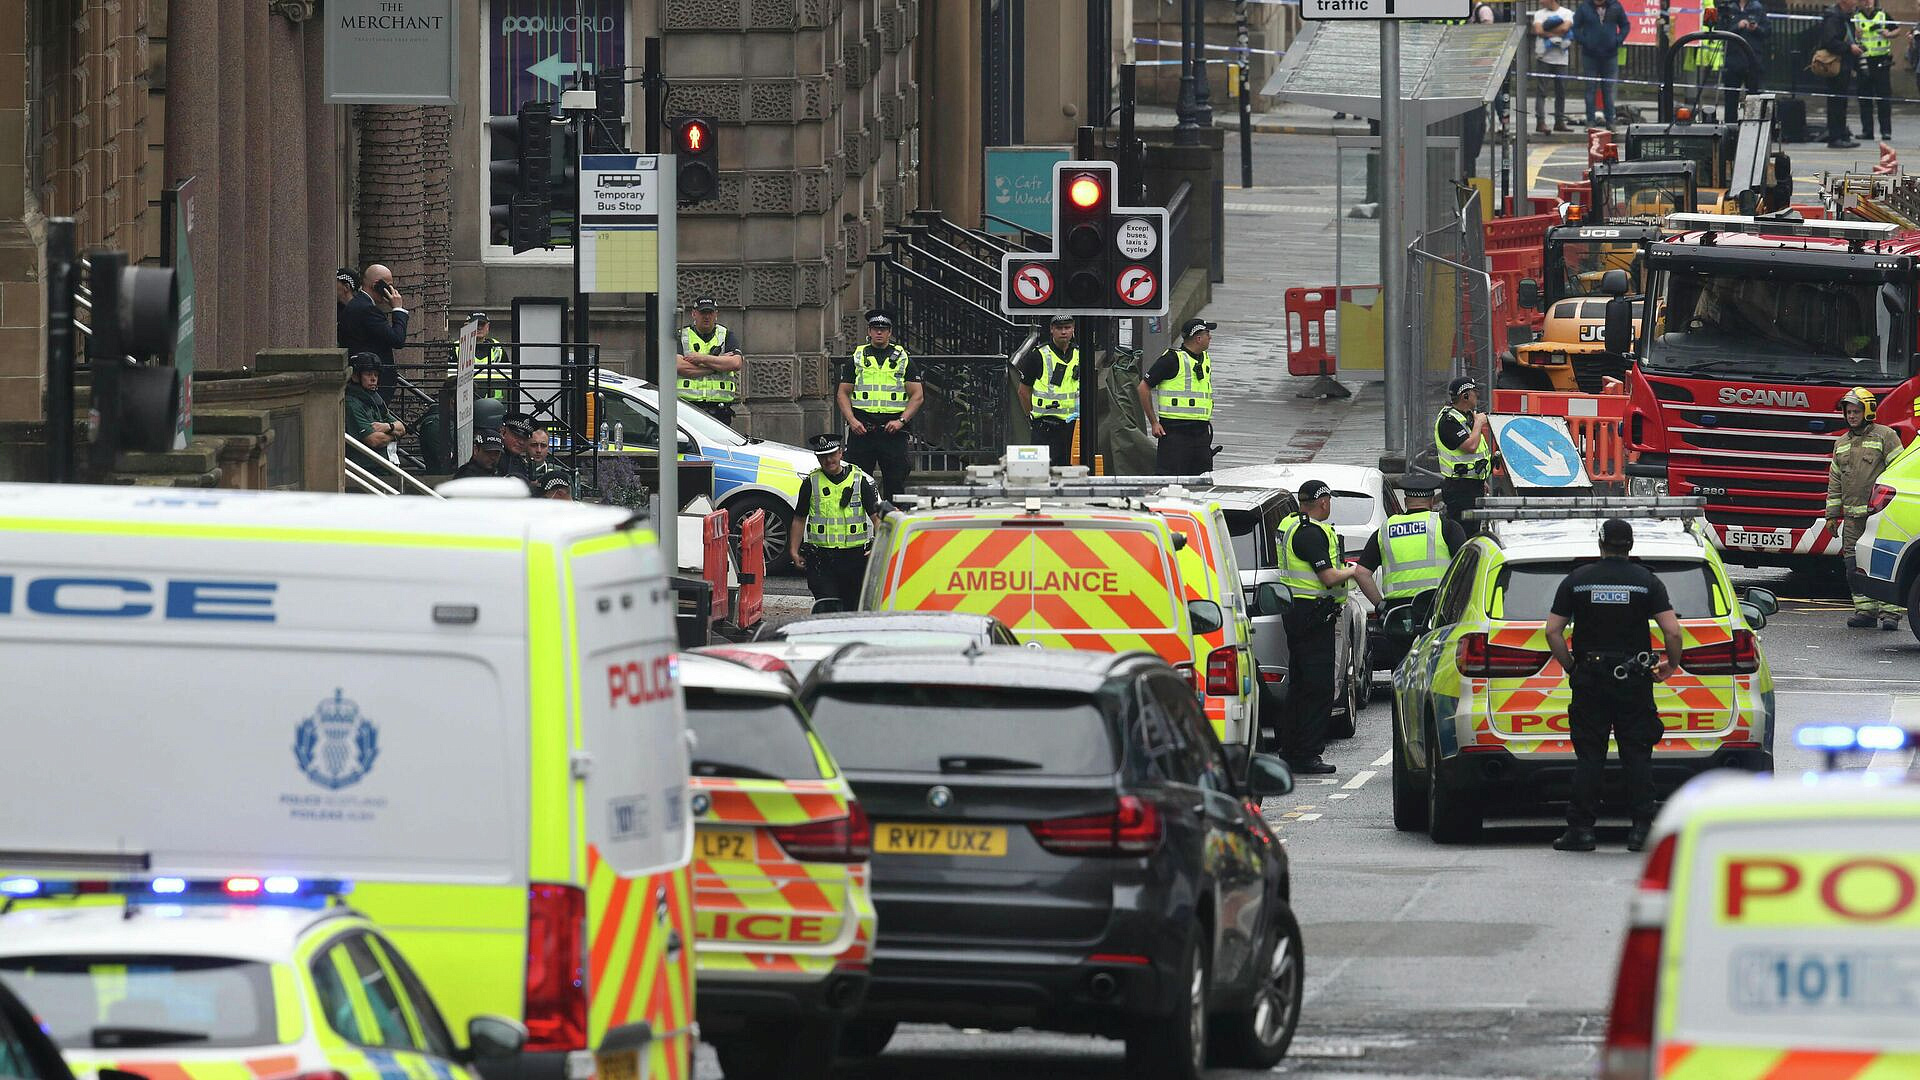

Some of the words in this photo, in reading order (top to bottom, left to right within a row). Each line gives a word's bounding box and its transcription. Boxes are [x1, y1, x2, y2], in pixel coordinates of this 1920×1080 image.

[380, 3, 404, 12] THE
[1317, 0, 1369, 11] traffic
[341, 15, 443, 29] MERCHANT
[594, 190, 645, 200] Temporary
[1015, 191, 1052, 204] Wand
[598, 202, 616, 211] Bus
[619, 202, 642, 212] Stop
[1126, 224, 1149, 232] Except
[1579, 229, 1620, 238] JCB
[1718, 387, 1810, 408] SCANIA
[1693, 486, 1701, 494] P
[1703, 487, 1726, 495] 280
[1389, 522, 1426, 537] POLICE
[1732, 532, 1758, 545] SF13
[1761, 534, 1785, 546] GXS
[947, 570, 1119, 592] AMBULANCE
[1593, 591, 1628, 601] POLICE
[1511, 712, 1715, 732] POCE
[889, 829, 939, 849] RV17
[947, 831, 992, 851] UXZ
[703, 836, 745, 858] LPZ
[1775, 957, 1851, 1004] 101
